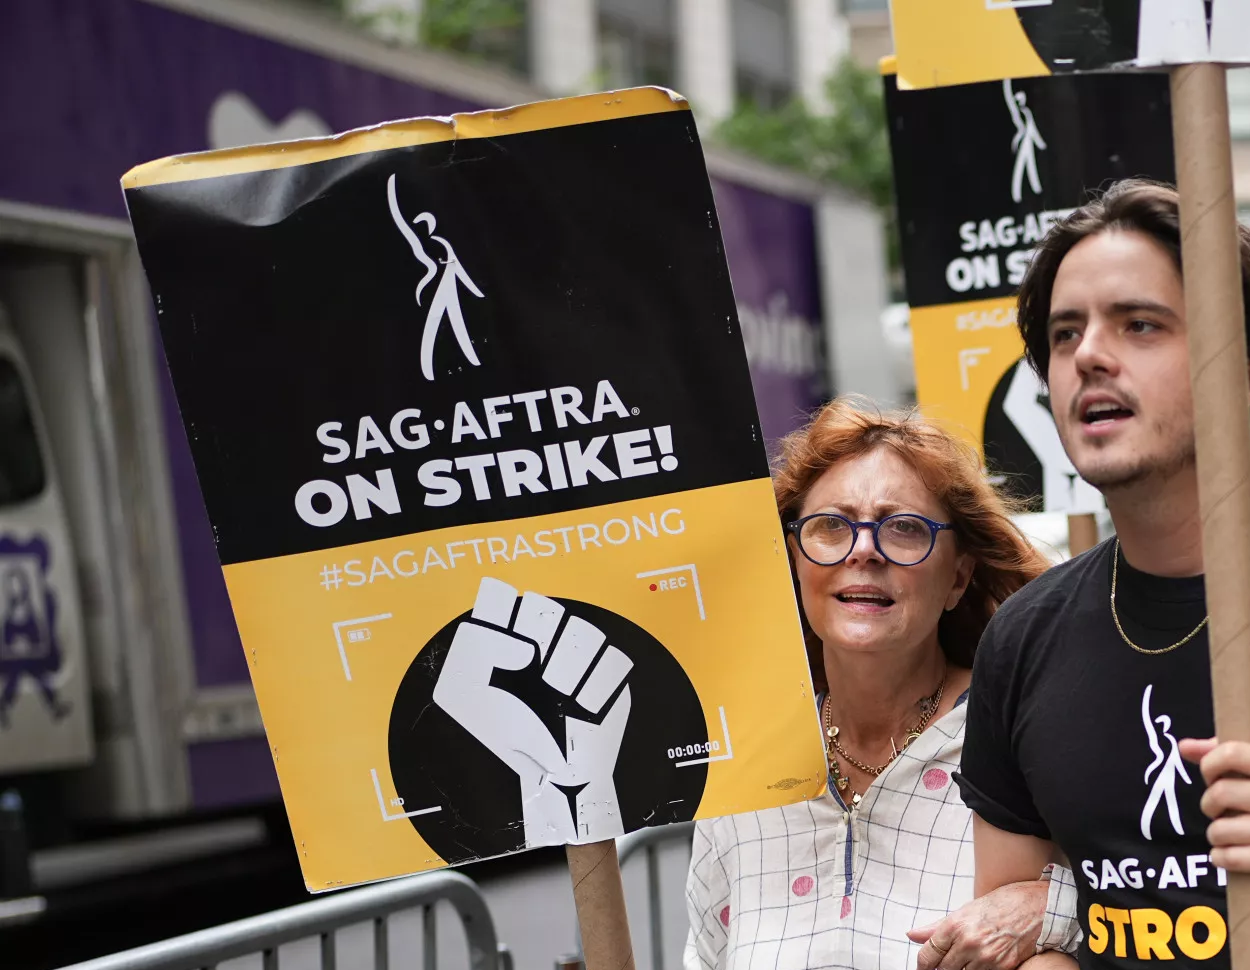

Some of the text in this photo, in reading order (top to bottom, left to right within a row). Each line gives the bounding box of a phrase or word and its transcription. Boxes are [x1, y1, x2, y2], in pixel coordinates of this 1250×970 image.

[959, 208, 1078, 252] SAG·AF
[946, 254, 1000, 292] ON
[294, 425, 679, 527] ON STRIKE!
[319, 508, 685, 590] #SAGAFTRASTRONG
[659, 576, 688, 592] REC
[667, 740, 720, 759] 00:00:00
[1081, 854, 1228, 889] SAG·AFT
